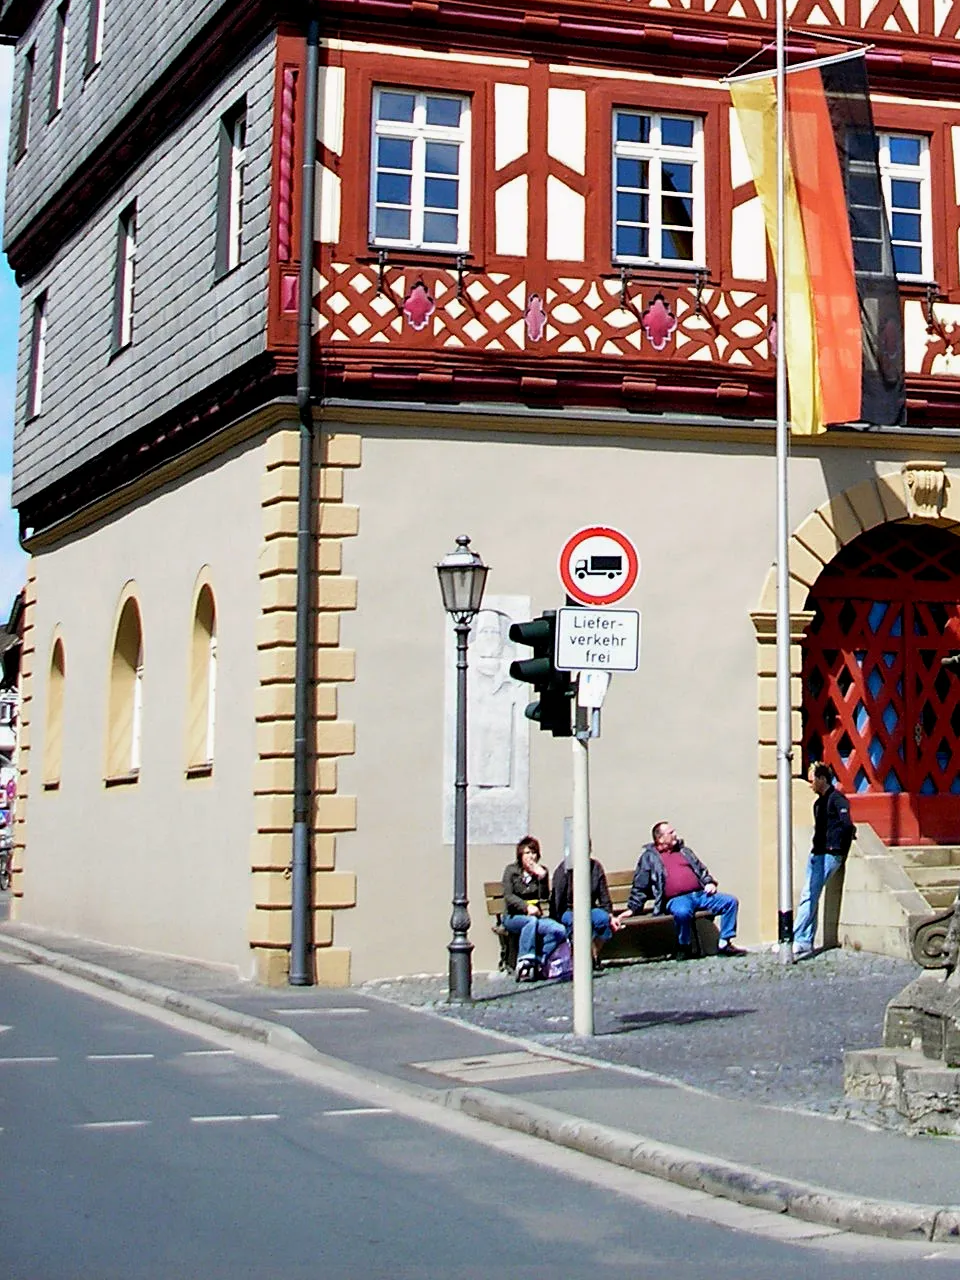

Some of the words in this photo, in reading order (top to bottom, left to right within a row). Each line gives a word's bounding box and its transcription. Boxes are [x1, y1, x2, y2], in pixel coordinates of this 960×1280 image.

[574, 615, 623, 629] Liefer-
[569, 633, 627, 646] verkehr
[586, 649, 610, 663] frei
